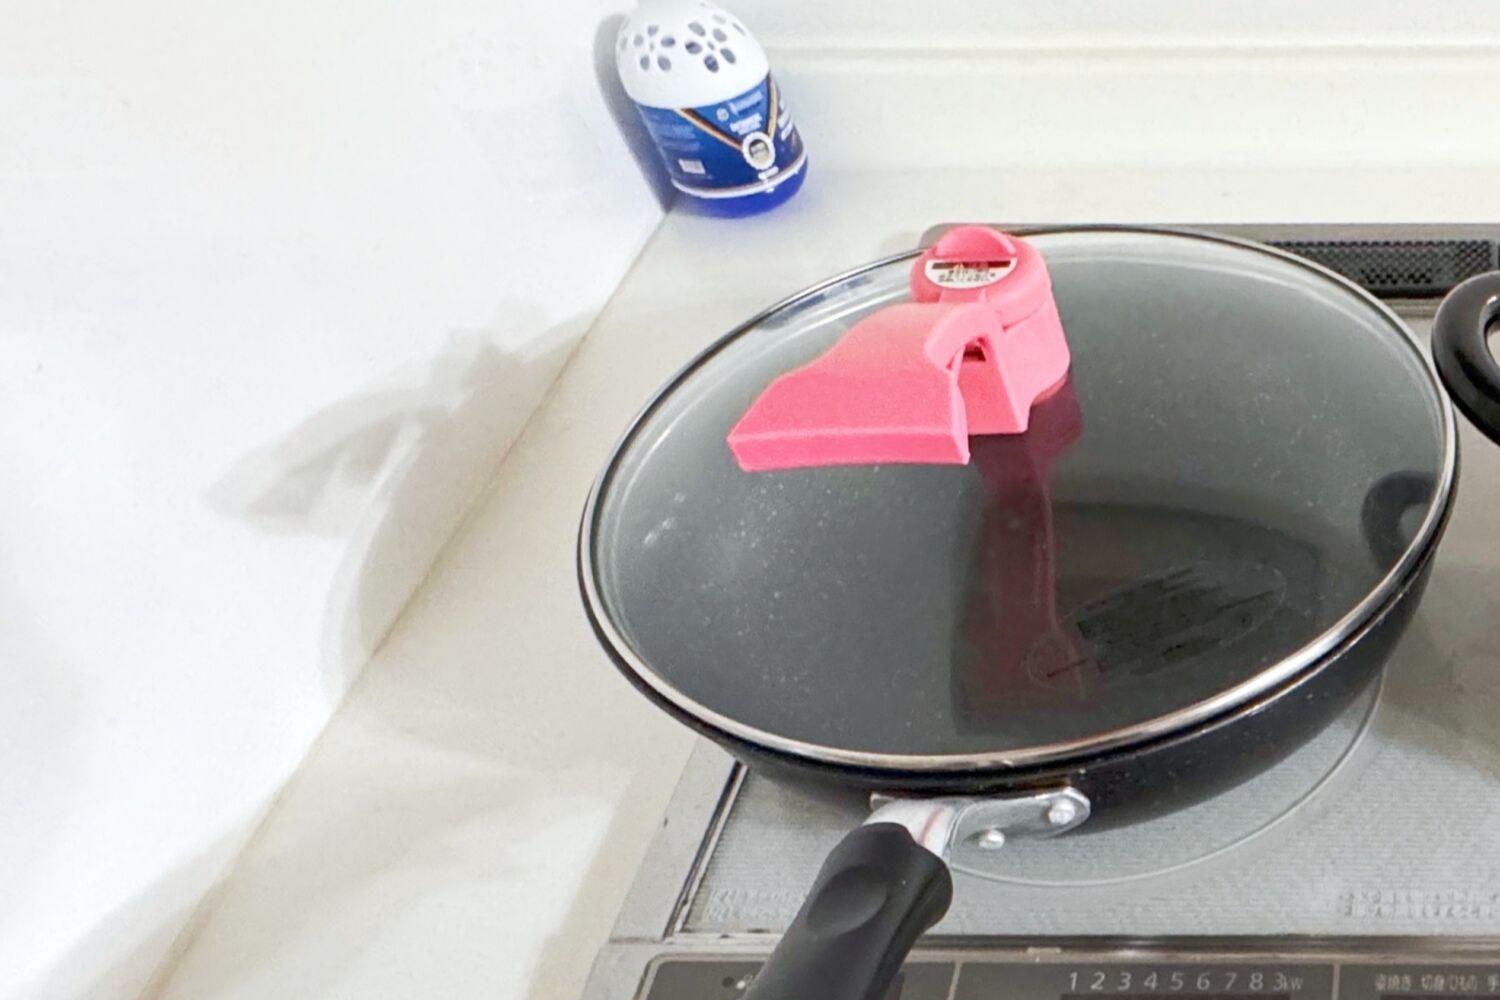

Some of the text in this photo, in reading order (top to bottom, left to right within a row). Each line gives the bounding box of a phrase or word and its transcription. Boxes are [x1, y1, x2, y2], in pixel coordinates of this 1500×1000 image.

[1069, 972, 1078, 991] 1
[1091, 972, 1105, 991] 2
[1117, 972, 1131, 991] 3
[1144, 972, 1158, 991] 4
[1170, 972, 1185, 991] 5
[1196, 972, 1210, 991] 6
[1224, 972, 1237, 991] 7
[1249, 972, 1264, 991] 8
